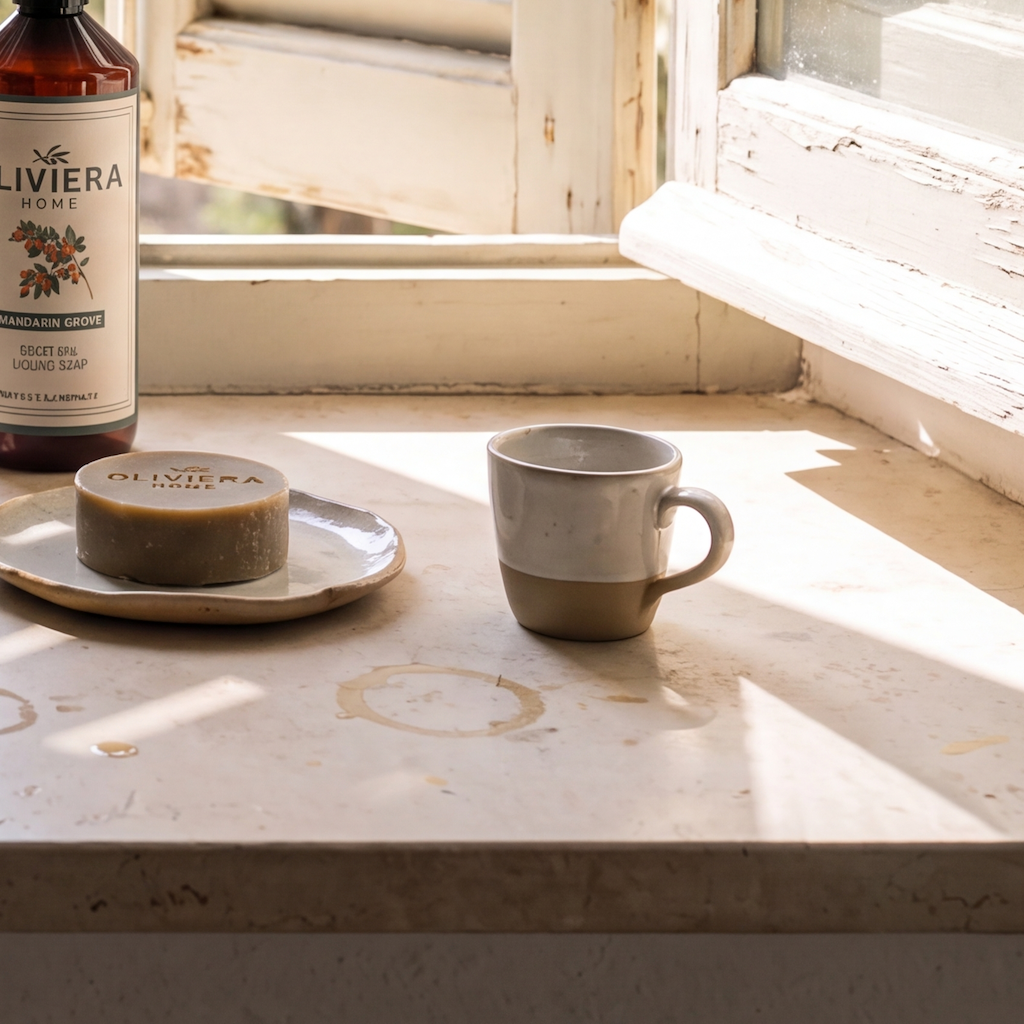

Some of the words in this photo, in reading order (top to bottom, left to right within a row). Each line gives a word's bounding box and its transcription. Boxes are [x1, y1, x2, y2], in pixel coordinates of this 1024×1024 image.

[21, 197, 78, 210] HOME
[64, 314, 103, 327] GROVE
[107, 472, 264, 485] OLIVIERA
